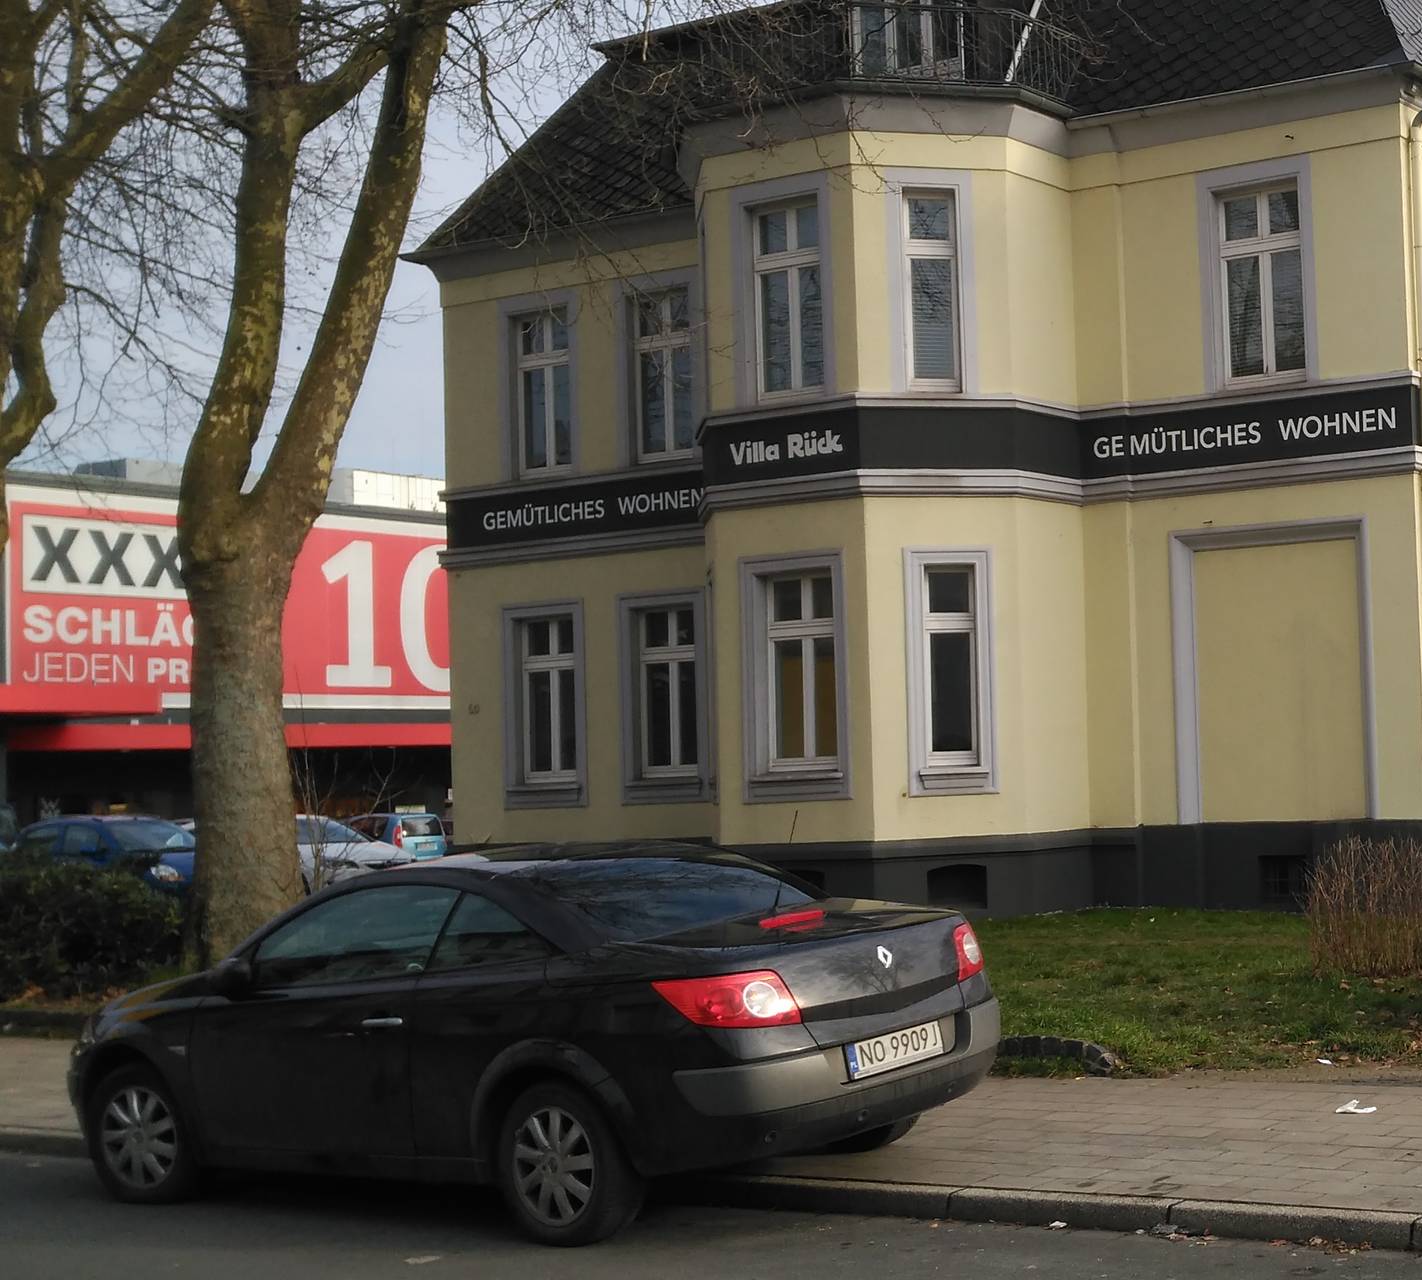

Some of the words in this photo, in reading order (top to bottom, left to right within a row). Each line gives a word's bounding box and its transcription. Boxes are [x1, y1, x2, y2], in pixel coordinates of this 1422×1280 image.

[1278, 407, 1397, 441] WOHNEN
[729, 440, 780, 465] Villa
[787, 429, 843, 459] Rück
[483, 504, 605, 530] GEMÜTLICHES
[617, 487, 704, 516] WOHNEN
[23, 652, 134, 683] JEDEN
[859, 1041, 886, 1067] NO
